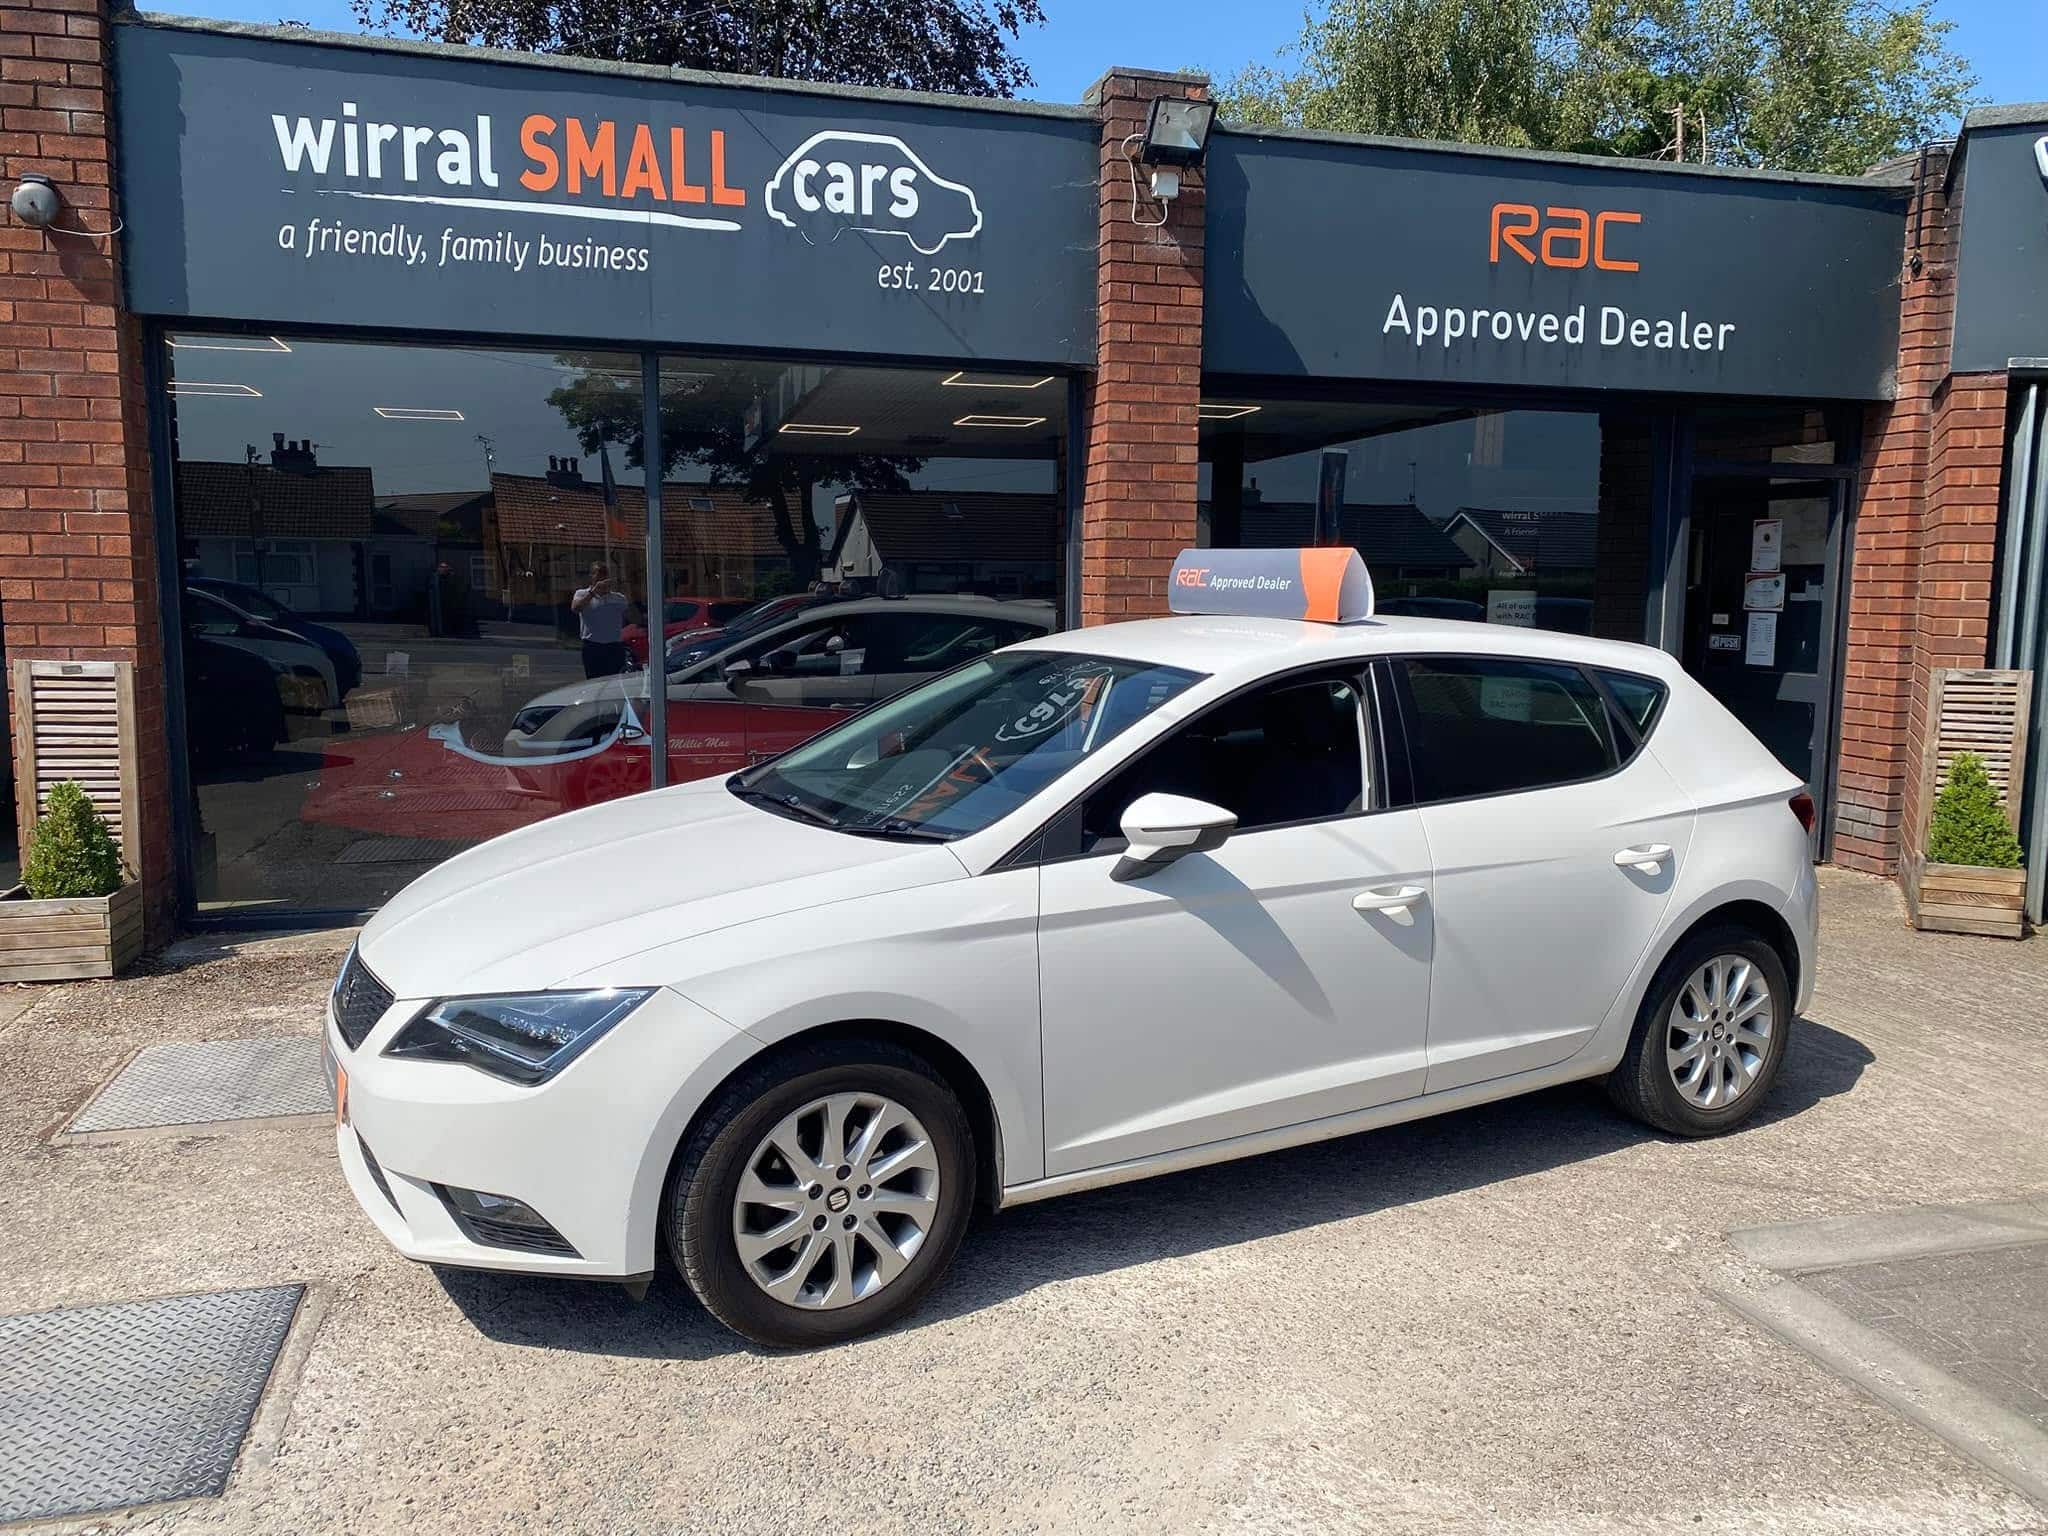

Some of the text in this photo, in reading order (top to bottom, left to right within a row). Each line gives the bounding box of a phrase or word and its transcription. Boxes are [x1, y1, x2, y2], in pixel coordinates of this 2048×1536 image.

[271, 101, 919, 220] wirral SMALL cars
[277, 217, 651, 273] a friendly, family business
[1490, 202, 1642, 272] RAC
[877, 260, 986, 295] est. 2001
[1381, 293, 1738, 352] Approved Dealer
[1176, 568, 1292, 591] RAC Approved Dealer
